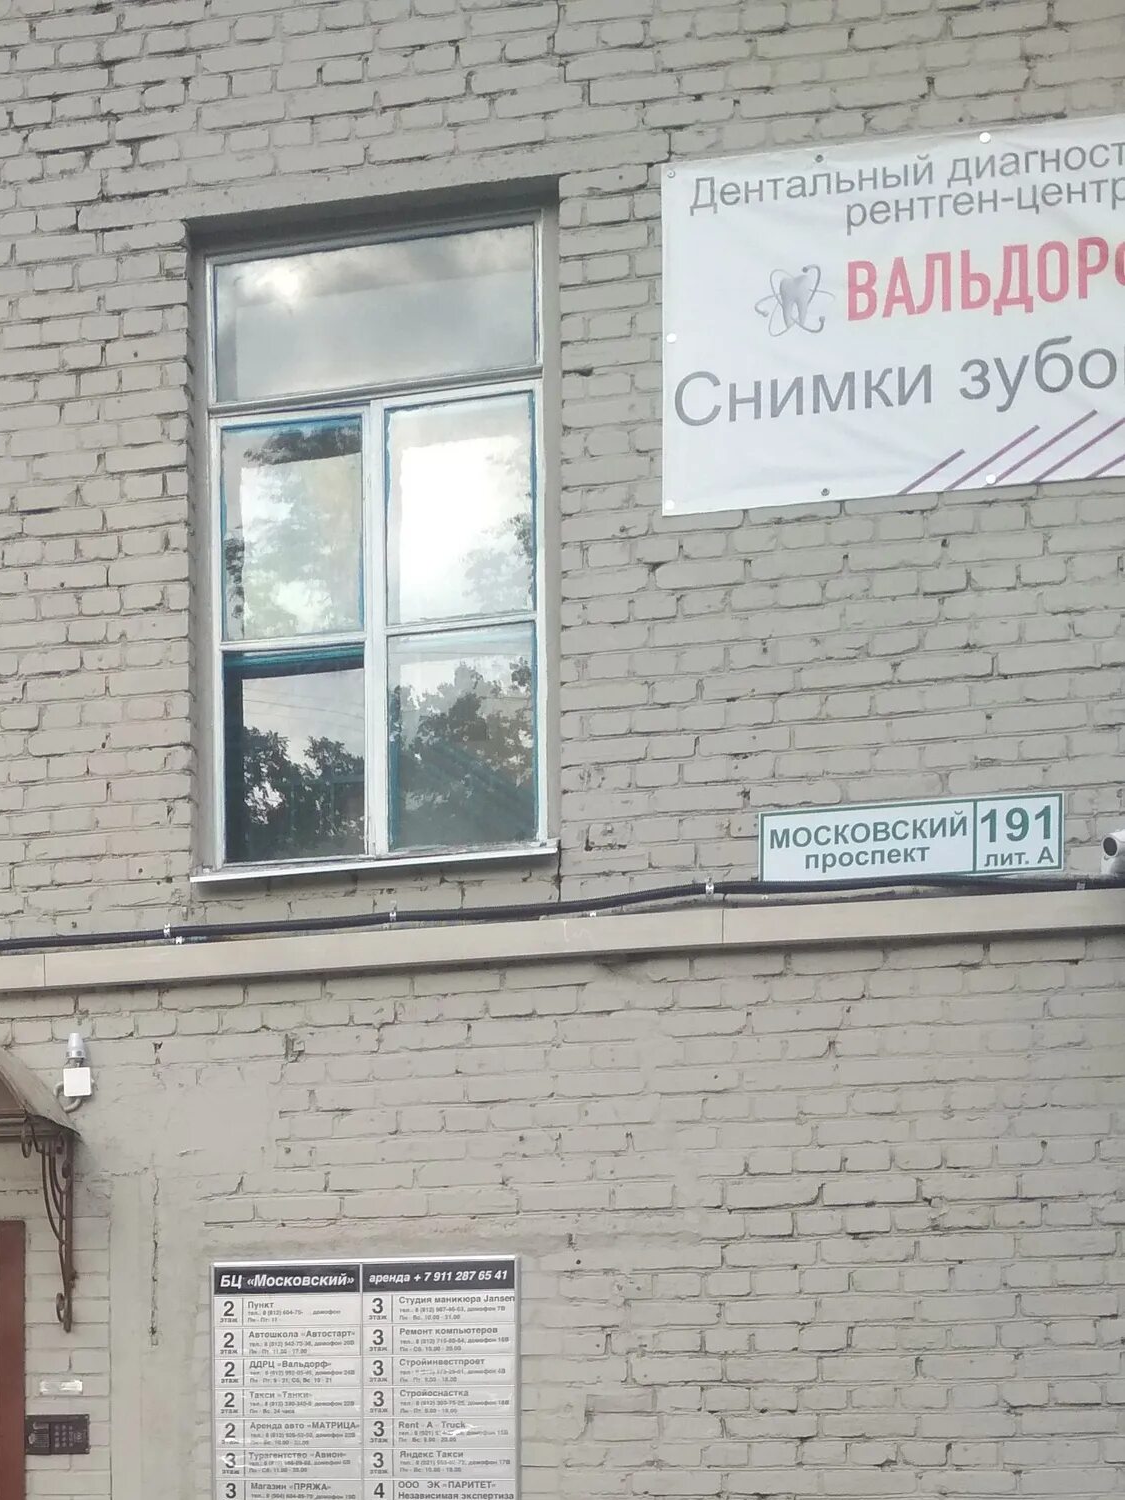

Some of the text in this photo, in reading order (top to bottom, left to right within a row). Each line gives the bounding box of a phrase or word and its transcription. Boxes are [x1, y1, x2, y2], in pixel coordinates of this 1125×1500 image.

[690, 155, 934, 215] Дентальный
[675, 335, 1125, 426] Снимки зубо
[770, 810, 967, 849] МОСКОВСКИЙ
[980, 805, 1052, 843] 191
[805, 847, 930, 873] проспект
[984, 846, 1054, 867] лит. А
[220, 1273, 355, 1289] БЦ «Московский»
[369, 1274, 411, 1285] аренда
[424, 1272, 433, 1281] 7
[433, 1271, 453, 1282] 911
[455, 1271, 477, 1281] 287
[478, 1270, 493, 1281] 65
[494, 1270, 508, 1280] 41
[247, 1301, 274, 1310] Пункт
[372, 1298, 384, 1314] 3
[399, 1294, 515, 1305] Студия маникюра Jansen
[223, 1301, 235, 1317] 2
[223, 1332, 235, 1348] 2
[249, 1330, 355, 1340] Автошкола «Автостарт»
[372, 1329, 384, 1345] 3
[399, 1328, 498, 1336] Ремонт компьютеров
[224, 1361, 235, 1377] 2
[249, 1360, 332, 1369] ДДРЦ «Вальдорф»
[373, 1360, 384, 1376] 3
[224, 1392, 235, 1408] 2
[249, 1391, 275, 1399] Такси
[373, 1391, 384, 1407] 3
[399, 1389, 469, 1398] Стройоснастка
[225, 1422, 236, 1438] 2
[250, 1421, 283, 1431] Аренда
[307, 1421, 360, 1430] «МАТРИЦА»
[373, 1421, 384, 1437] 3
[398, 1421, 419, 1429] Rent
[441, 1421, 466, 1429] Truck
[225, 1452, 236, 1468] 3
[249, 1452, 307, 1460] Турагентство
[373, 1452, 384, 1468] 3
[400, 1451, 434, 1459] Яндекс
[225, 1483, 236, 1498] 3
[251, 1482, 331, 1491] Магазин «ПРЯЖА»
[373, 1483, 385, 1498] 4
[442, 1481, 496, 1489] «ПАРИТЕТ»
[398, 1492, 514, 1500] Независимая экспертиза
